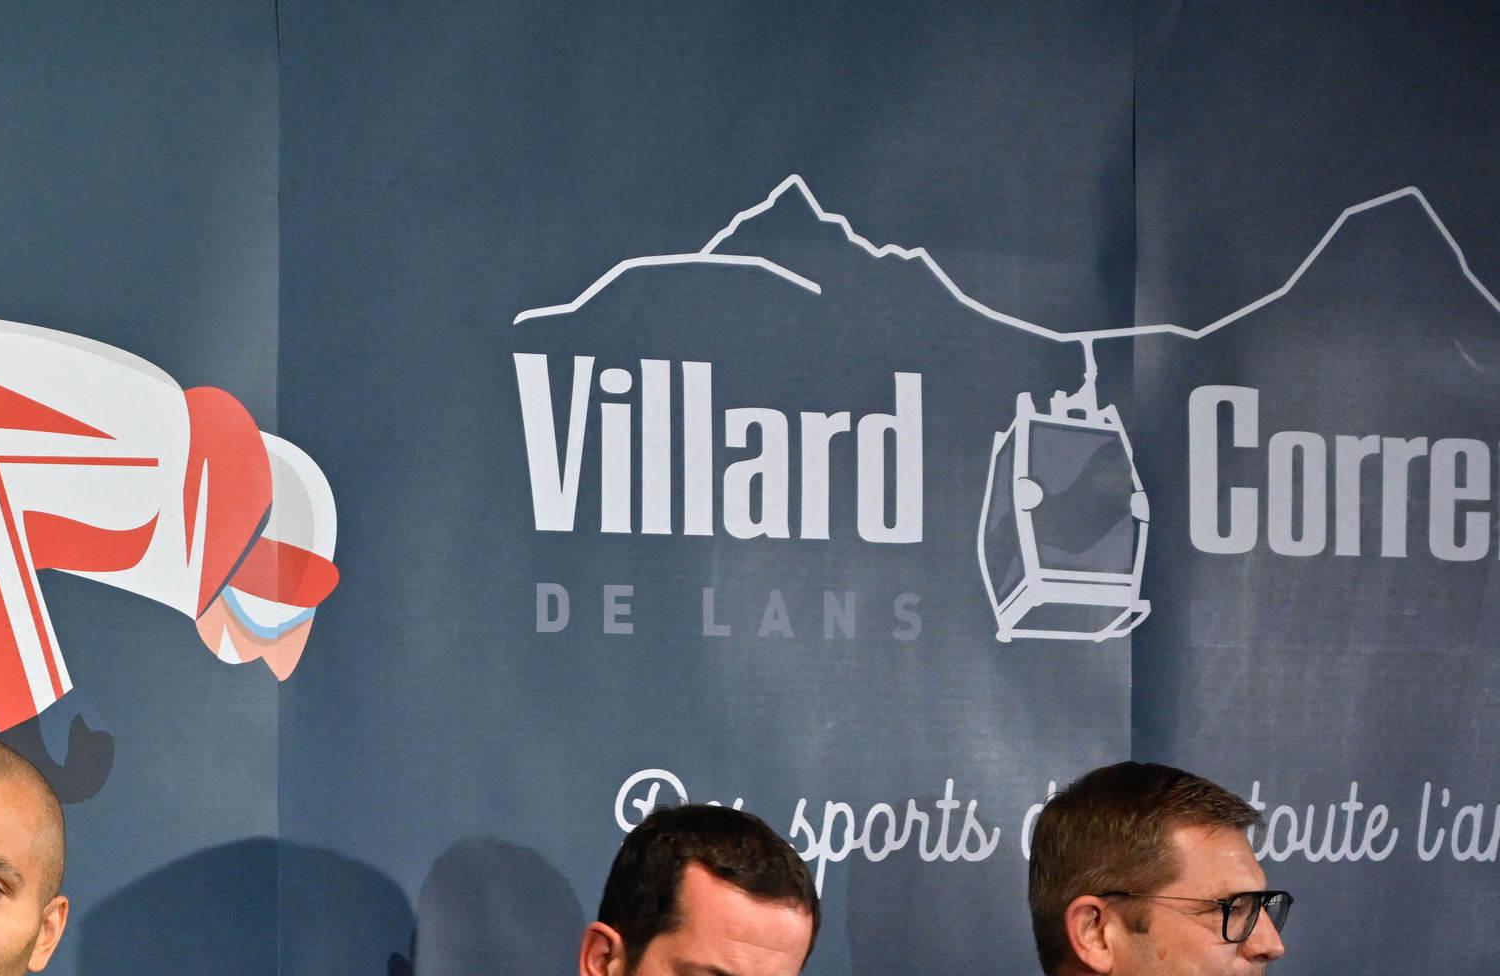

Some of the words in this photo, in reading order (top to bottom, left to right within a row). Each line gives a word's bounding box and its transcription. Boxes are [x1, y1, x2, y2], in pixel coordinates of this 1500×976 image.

[513, 353, 923, 543] Villard
[1188, 384, 1500, 562] Corre
[536, 582, 634, 634] DE
[702, 587, 923, 640] LANS
[789, 777, 1000, 898] sports
[1248, 780, 1399, 862] toute
